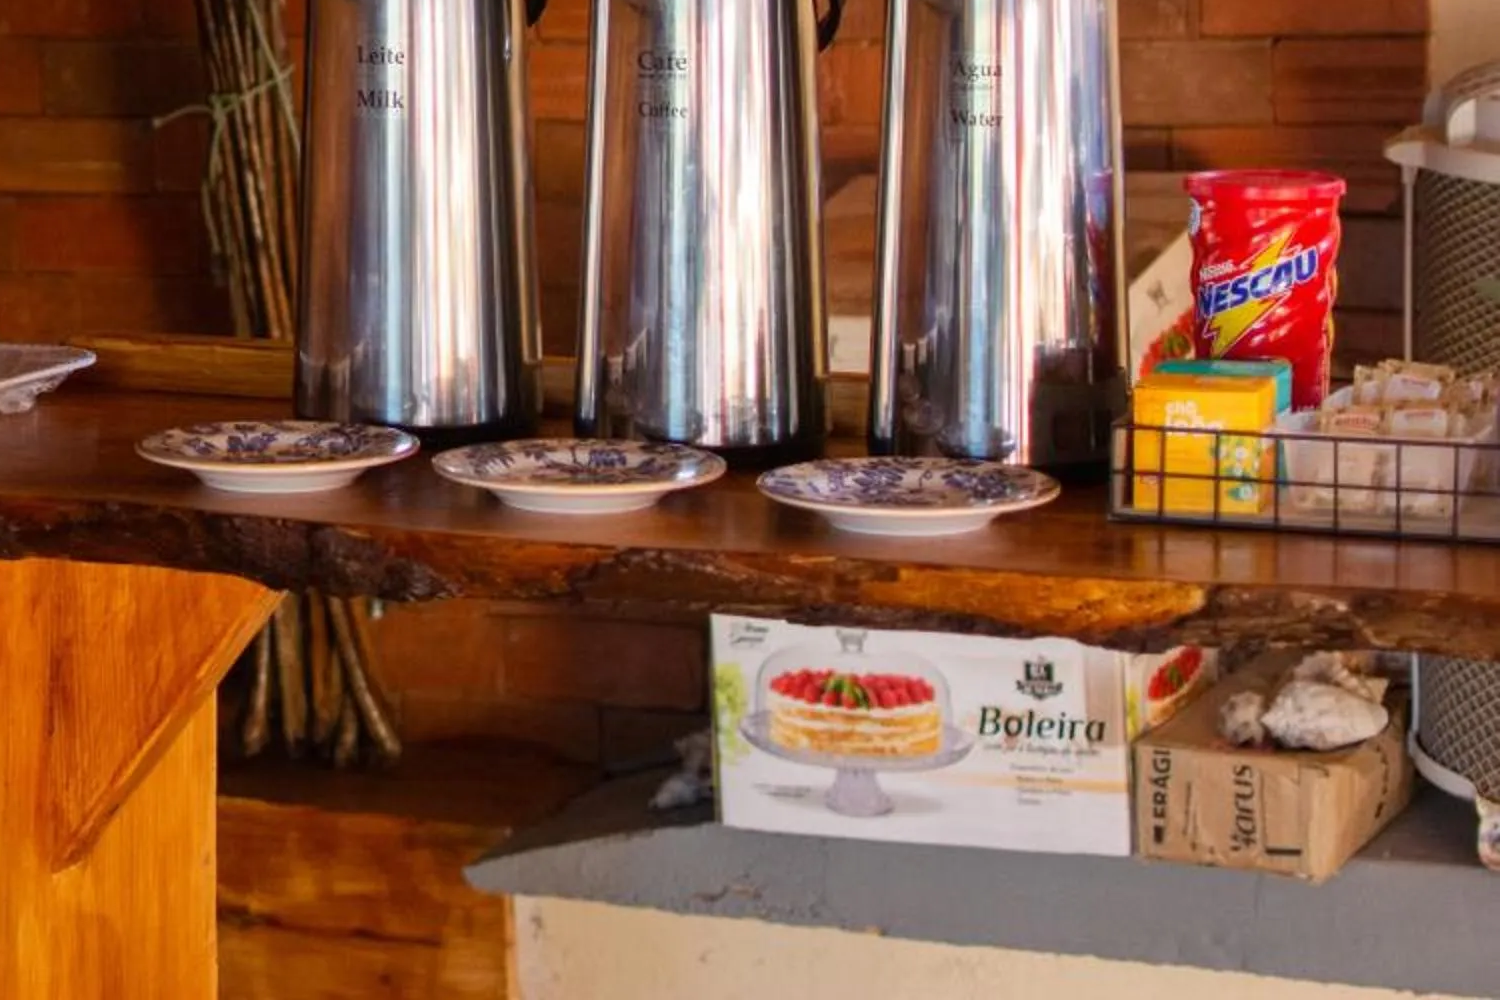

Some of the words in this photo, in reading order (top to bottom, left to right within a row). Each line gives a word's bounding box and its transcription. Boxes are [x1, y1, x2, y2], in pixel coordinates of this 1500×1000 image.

[356, 45, 405, 65] Leite
[356, 89, 405, 109] Milk
[637, 100, 688, 119] Coffee
[950, 108, 1004, 127] Water
[1197, 246, 1320, 319] NESCAU
[978, 704, 1107, 743] Boleira
[1148, 749, 1171, 819] FRÁGI
